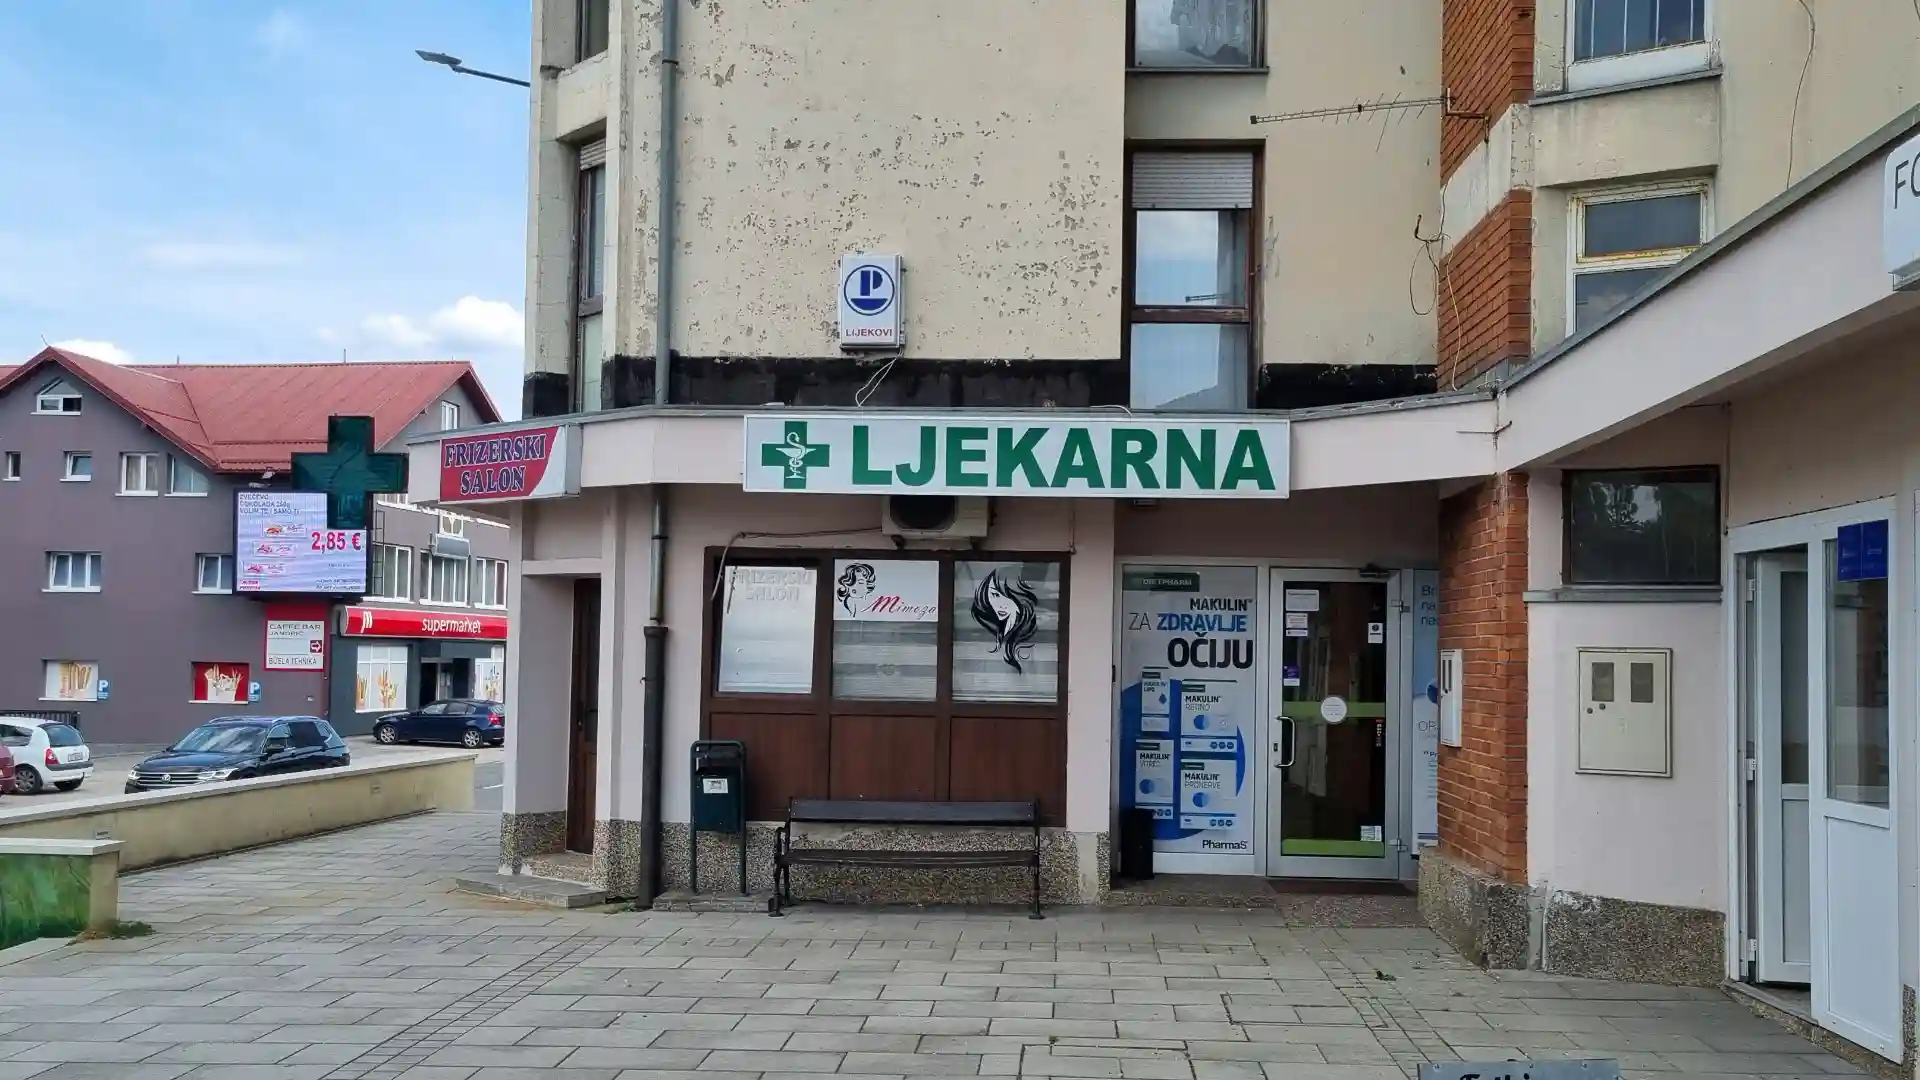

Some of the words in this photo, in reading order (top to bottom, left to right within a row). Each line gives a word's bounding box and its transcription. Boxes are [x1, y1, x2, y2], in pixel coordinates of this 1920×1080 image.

[846, 328, 892, 337] LIJEKOVI
[444, 434, 547, 468] FRIZERSKI
[851, 425, 1276, 491] LJEKARNA
[460, 466, 526, 495] SALON
[311, 532, 346, 554] 2,85
[352, 532, 361, 550] €
[860, 595, 937, 620] Mimoza
[421, 616, 481, 635] supermarket
[1128, 612, 1152, 631] ZA
[1157, 613, 1247, 632] ZDRAVLJE
[1167, 631, 1253, 669] OČIJU
[269, 657, 289, 665] BIJELA
[291, 657, 317, 665] TEHNIKA
[99, 680, 108, 691] P
[250, 682, 260, 693] P
[1185, 695, 1220, 703] MAKULIN
[1184, 772, 1220, 780] MAKULIN
[1202, 839, 1247, 850] PharmaS
